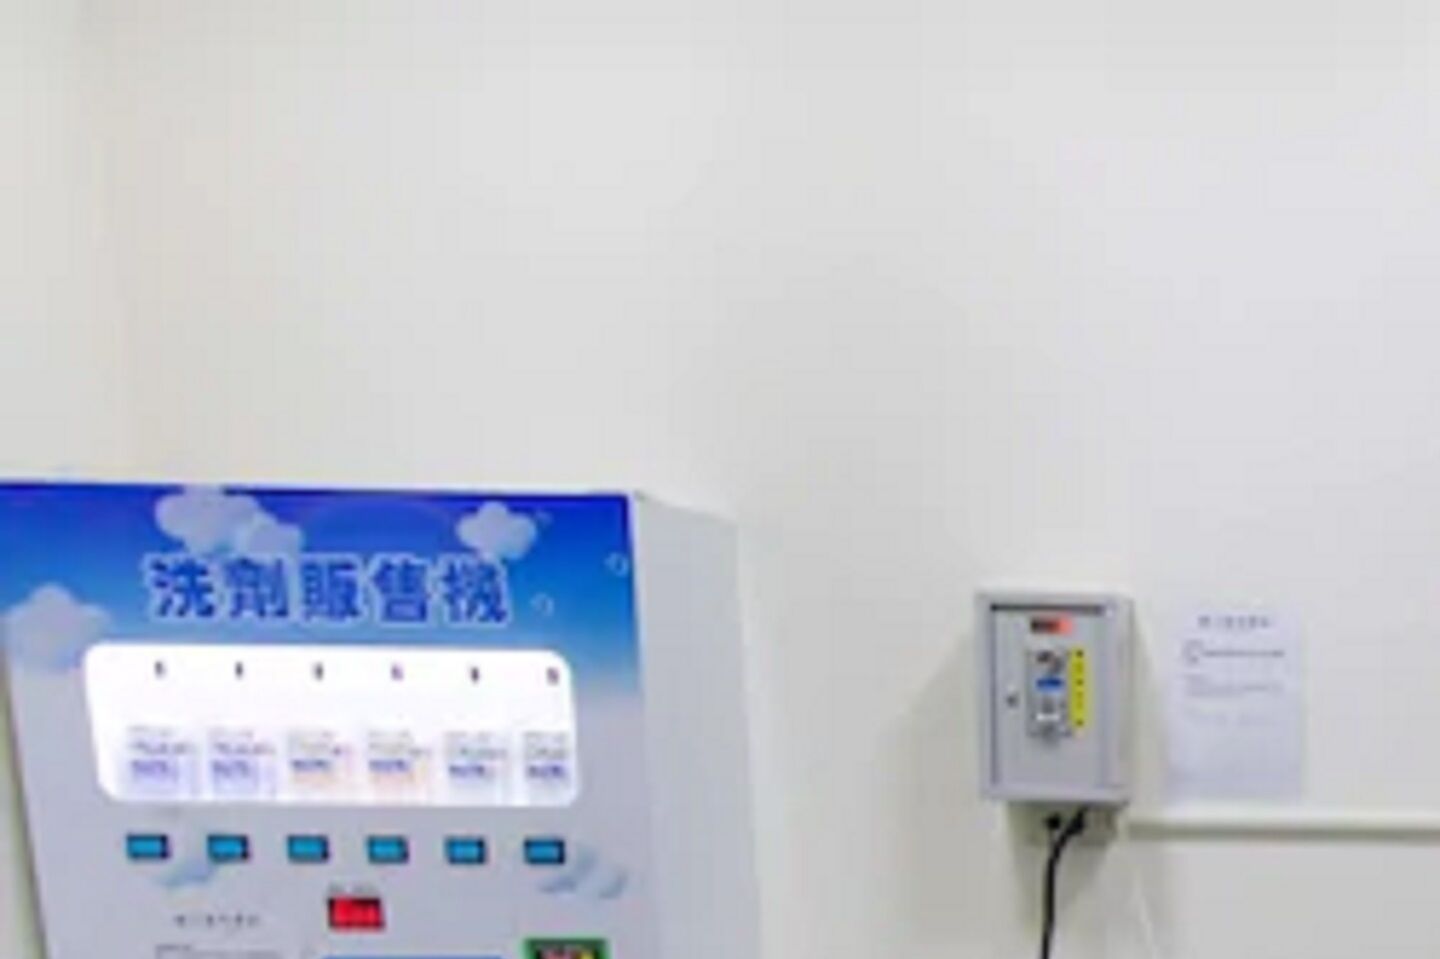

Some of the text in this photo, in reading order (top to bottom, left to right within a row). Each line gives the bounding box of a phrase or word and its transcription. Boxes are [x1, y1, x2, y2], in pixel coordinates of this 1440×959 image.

[146, 554, 510, 625] 洗劑販售機
